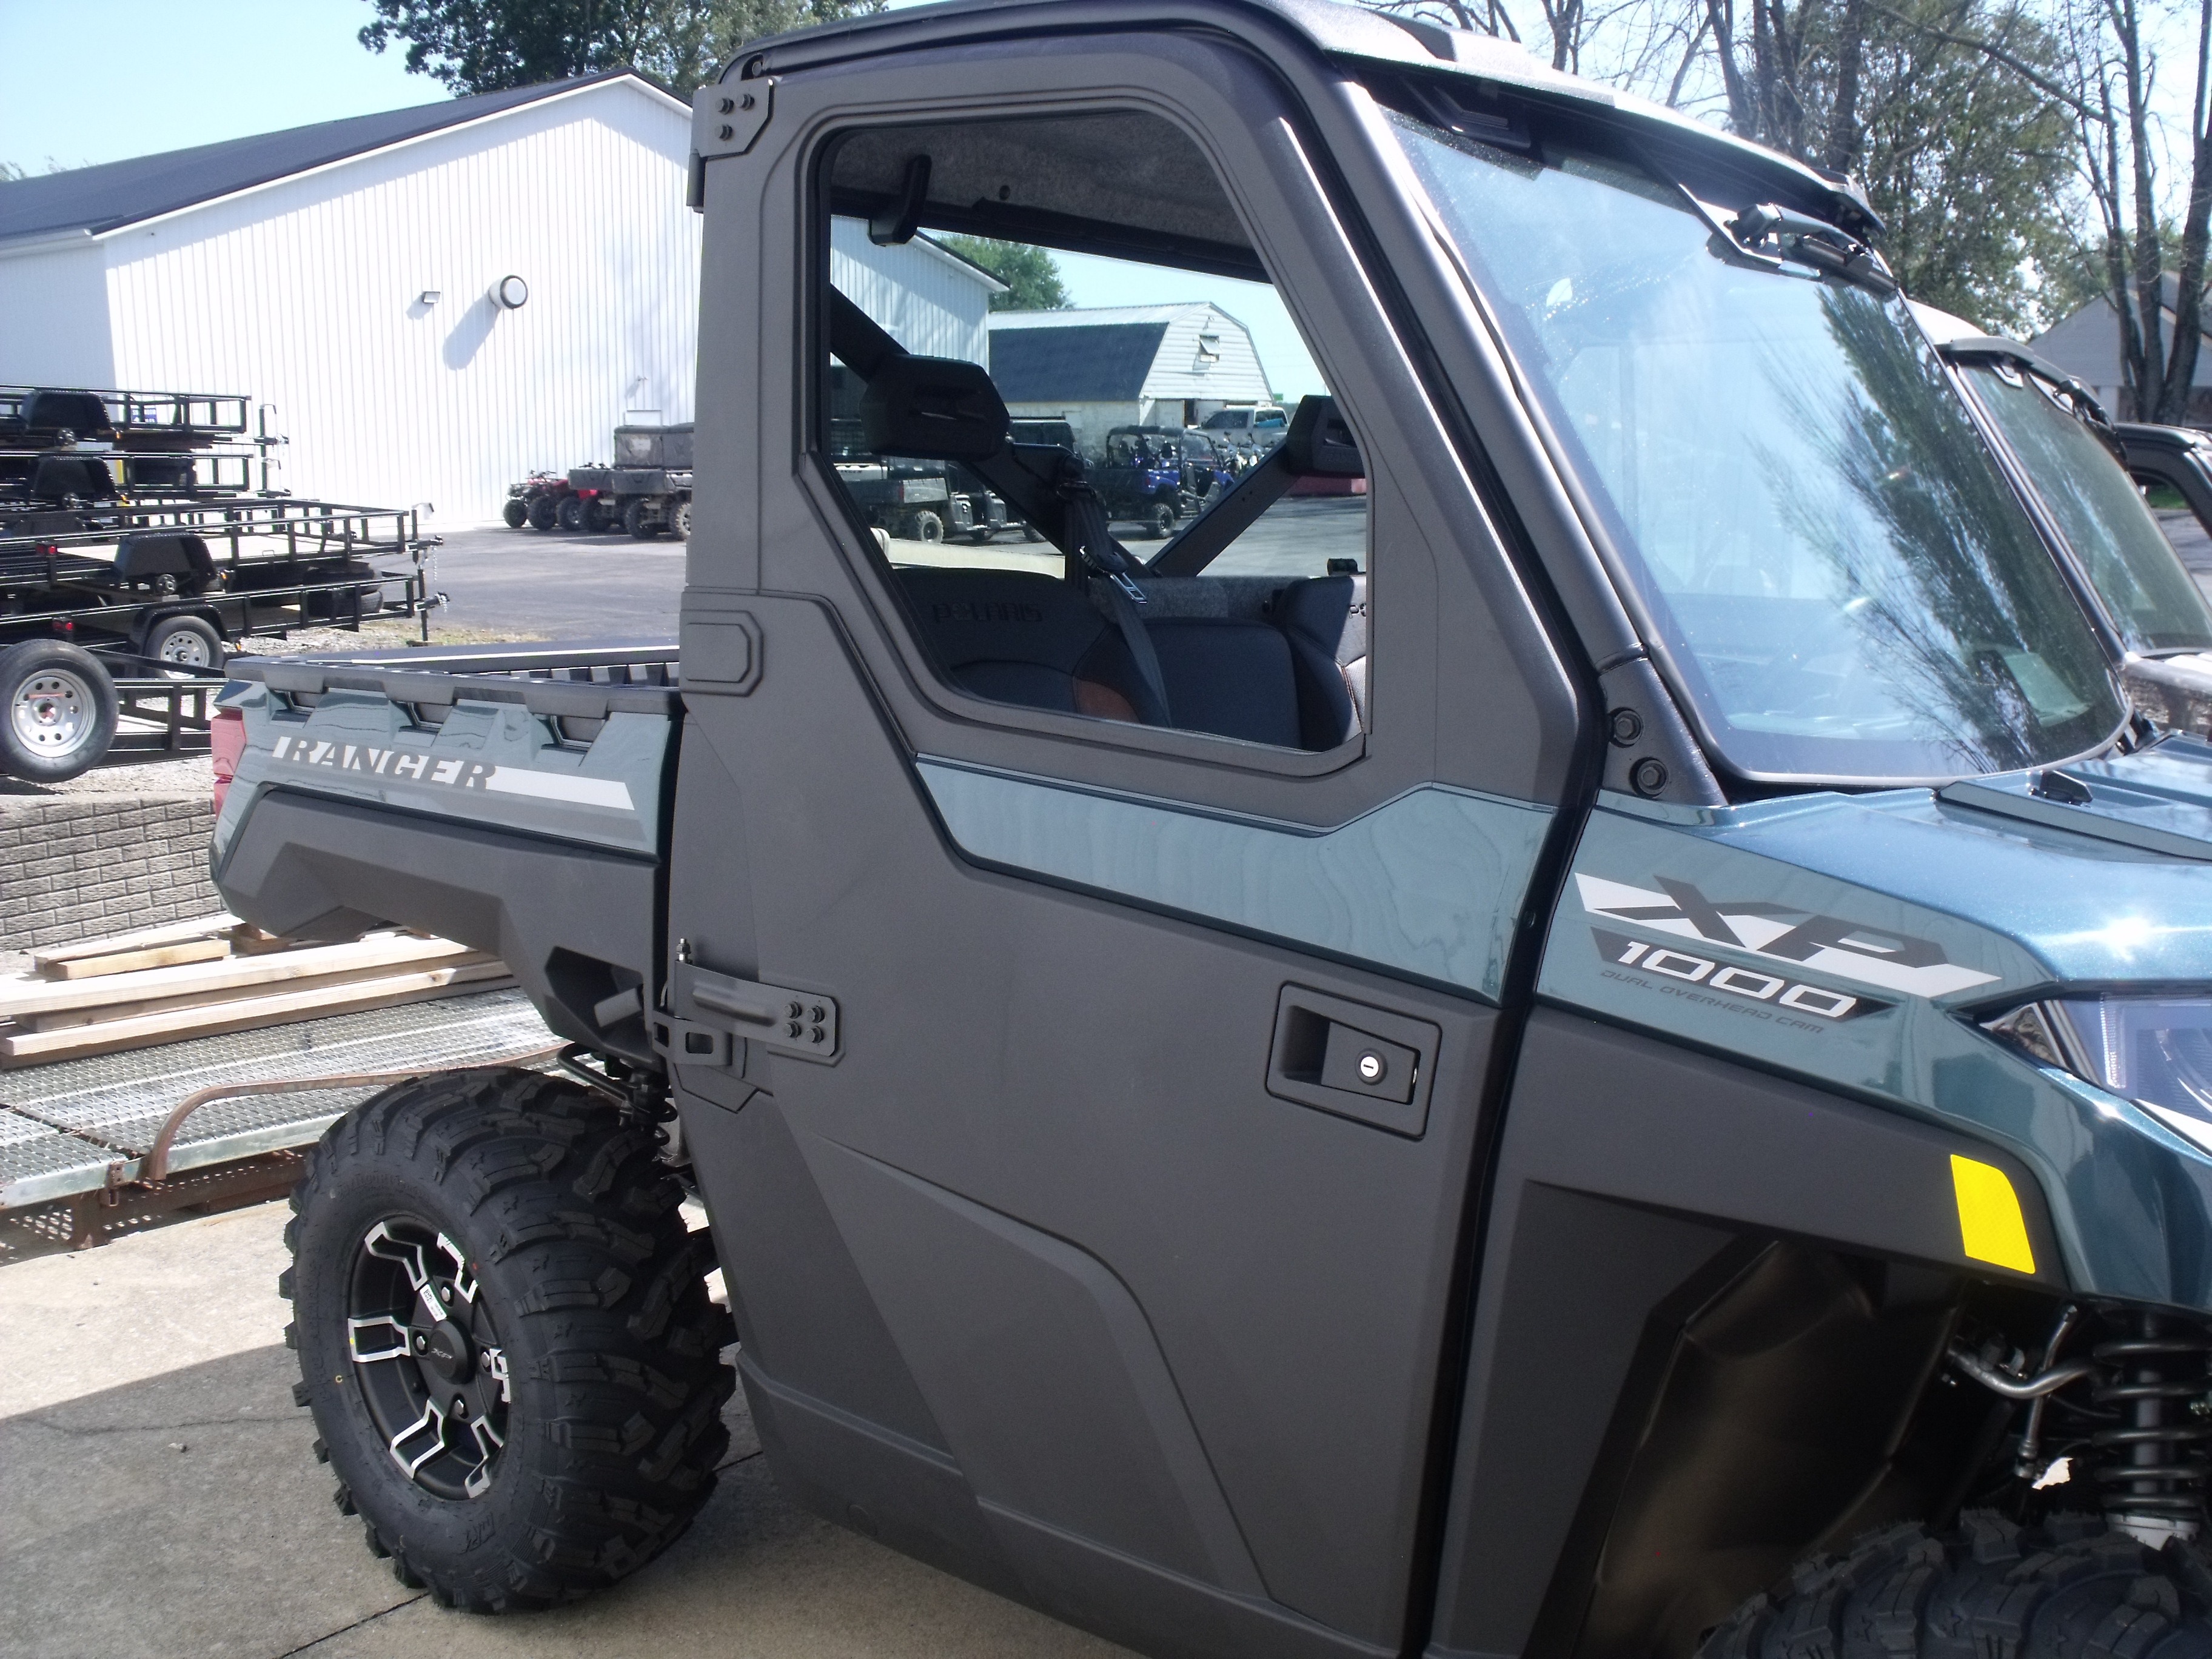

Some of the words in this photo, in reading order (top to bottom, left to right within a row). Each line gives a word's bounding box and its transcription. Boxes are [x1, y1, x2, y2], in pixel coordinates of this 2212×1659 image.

[281, 736, 497, 789] RANGER
[1592, 874, 1949, 970] XP
[1600, 970, 1653, 990] DUAL
[1659, 986, 1772, 1020] OVERHEAD
[1775, 1016, 1825, 1034] CAM
[1617, 941, 1857, 1018] 1000
